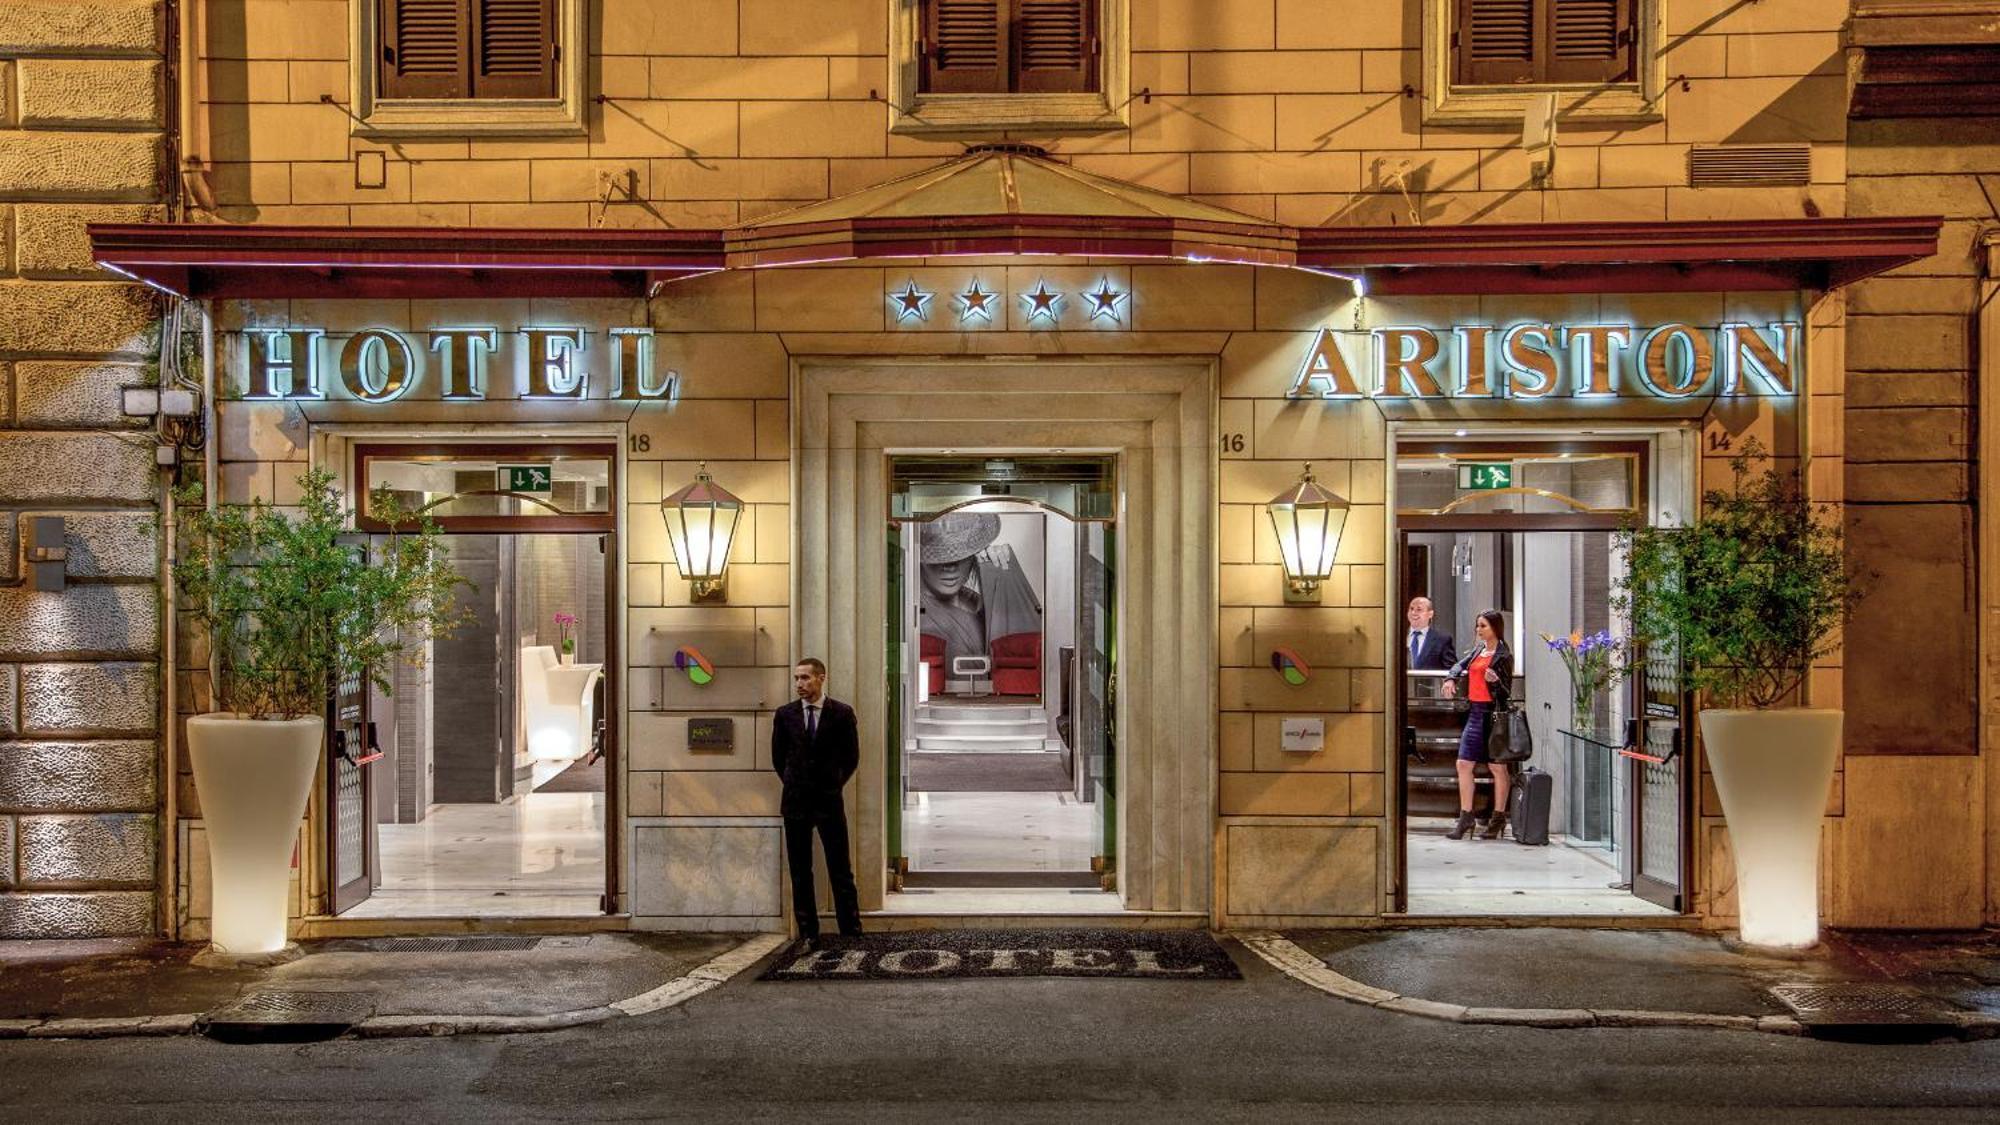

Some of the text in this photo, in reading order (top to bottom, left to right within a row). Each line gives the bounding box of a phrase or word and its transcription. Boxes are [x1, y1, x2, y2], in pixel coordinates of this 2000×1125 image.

[242, 321, 1798, 404] HOTEL ARISTON
[630, 434, 650, 452] 18
[1221, 433, 1244, 452] 16
[1708, 431, 1731, 450] 14
[777, 949, 1204, 974] HOTEL
